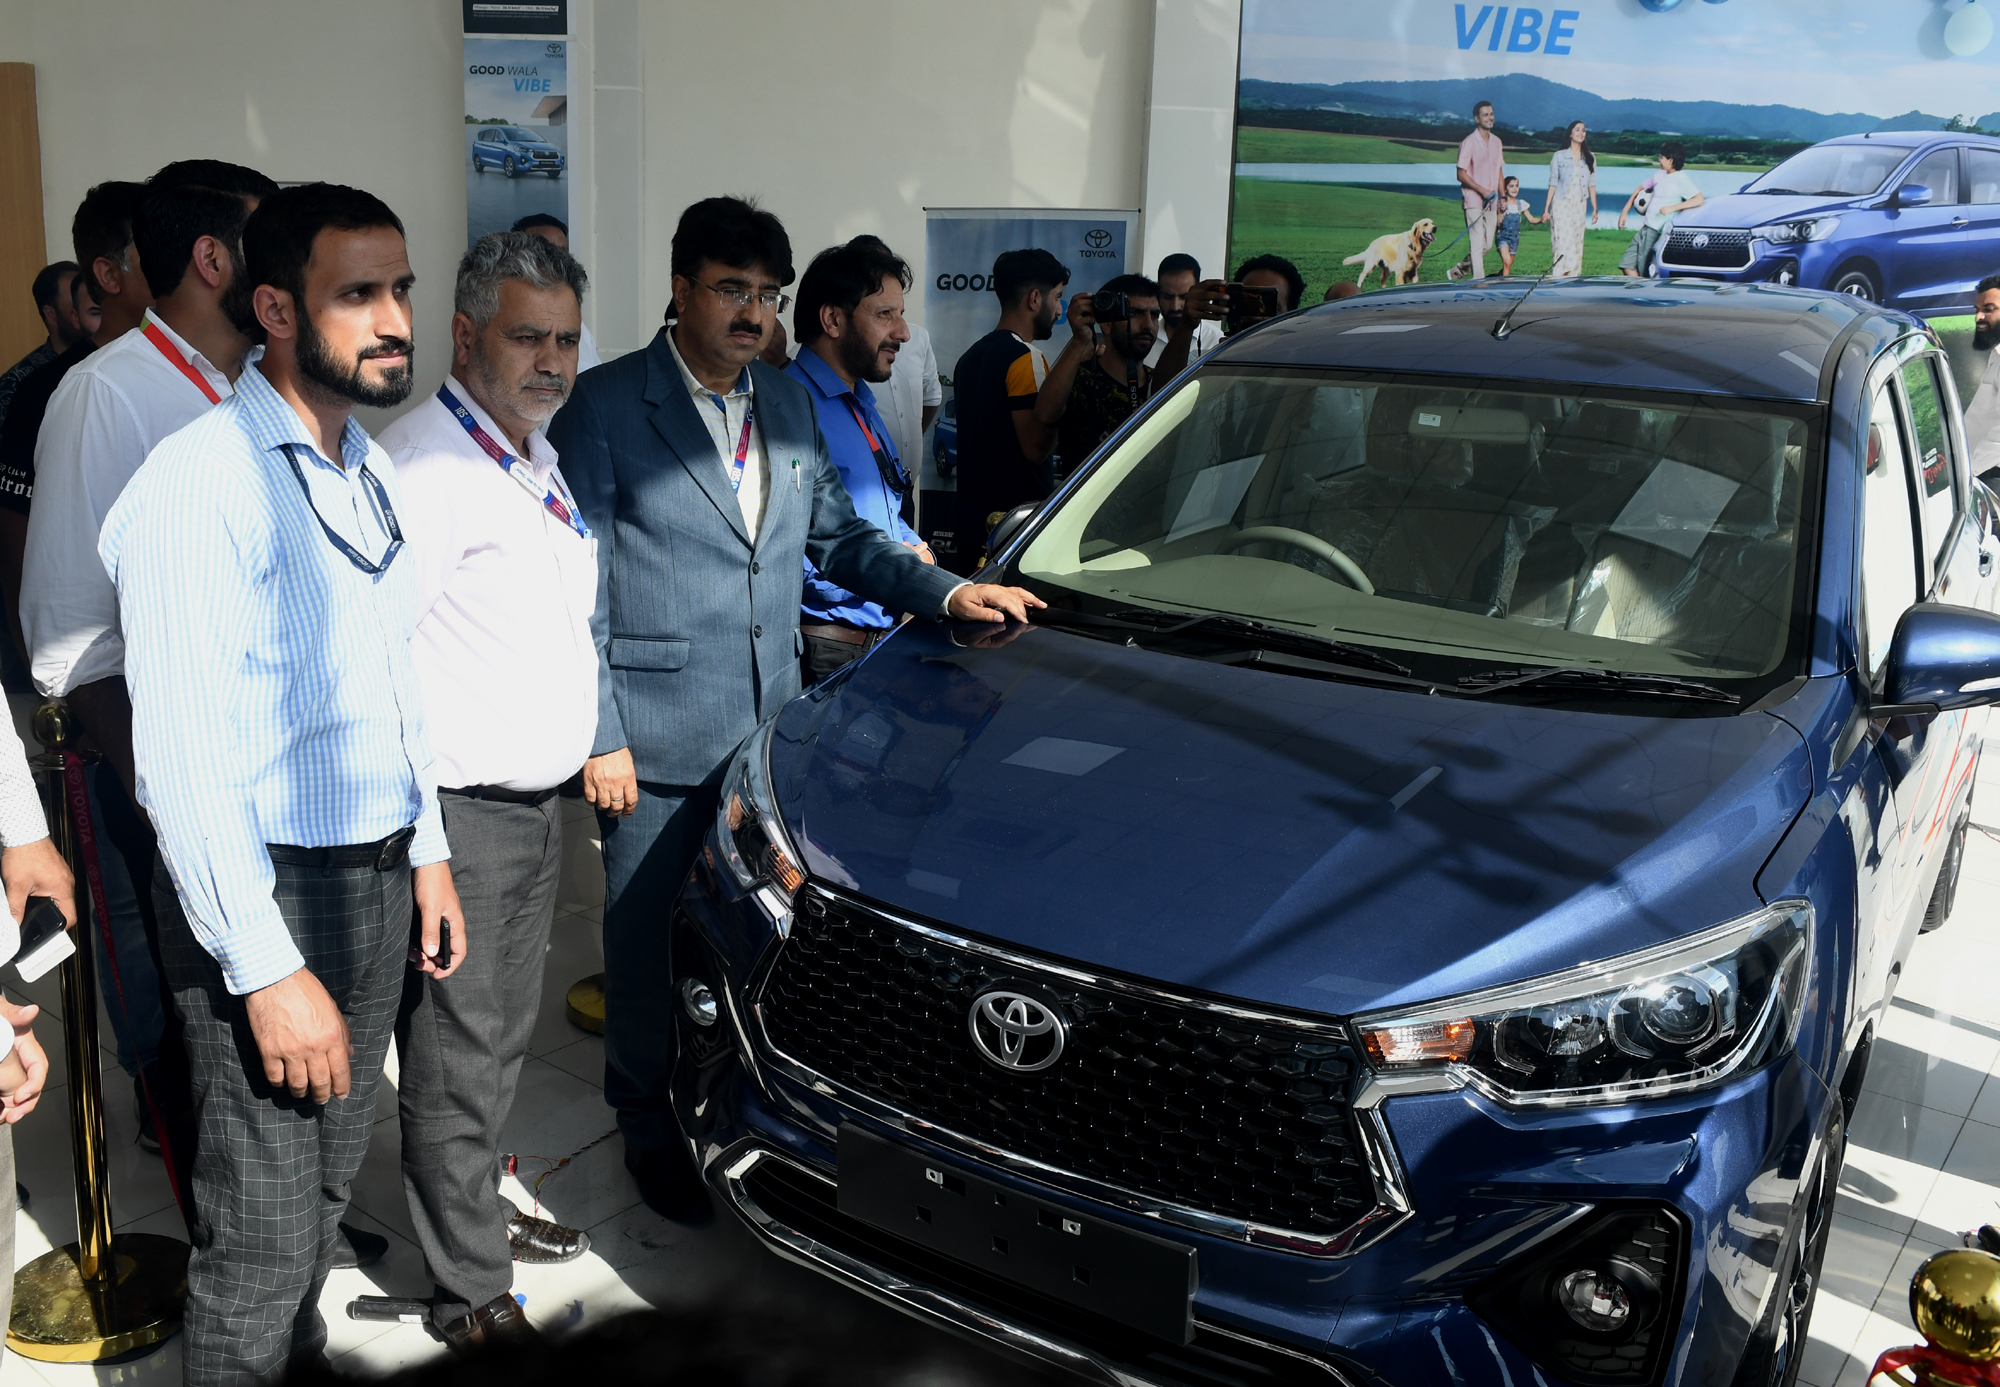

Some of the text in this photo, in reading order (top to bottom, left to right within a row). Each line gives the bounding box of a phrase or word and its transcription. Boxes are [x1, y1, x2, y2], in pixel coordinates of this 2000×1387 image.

[1454, 4, 1580, 55] VIBE
[469, 65, 538, 76] GOOD WALA
[513, 78, 551, 93] VIBE
[1079, 250, 1116, 259] TOYOTA
[454, 406, 469, 419] SBI
[731, 467, 743, 482] SBI
[72, 787, 92, 845] TOYOTA
[93, 883, 110, 938] TOYOTA
